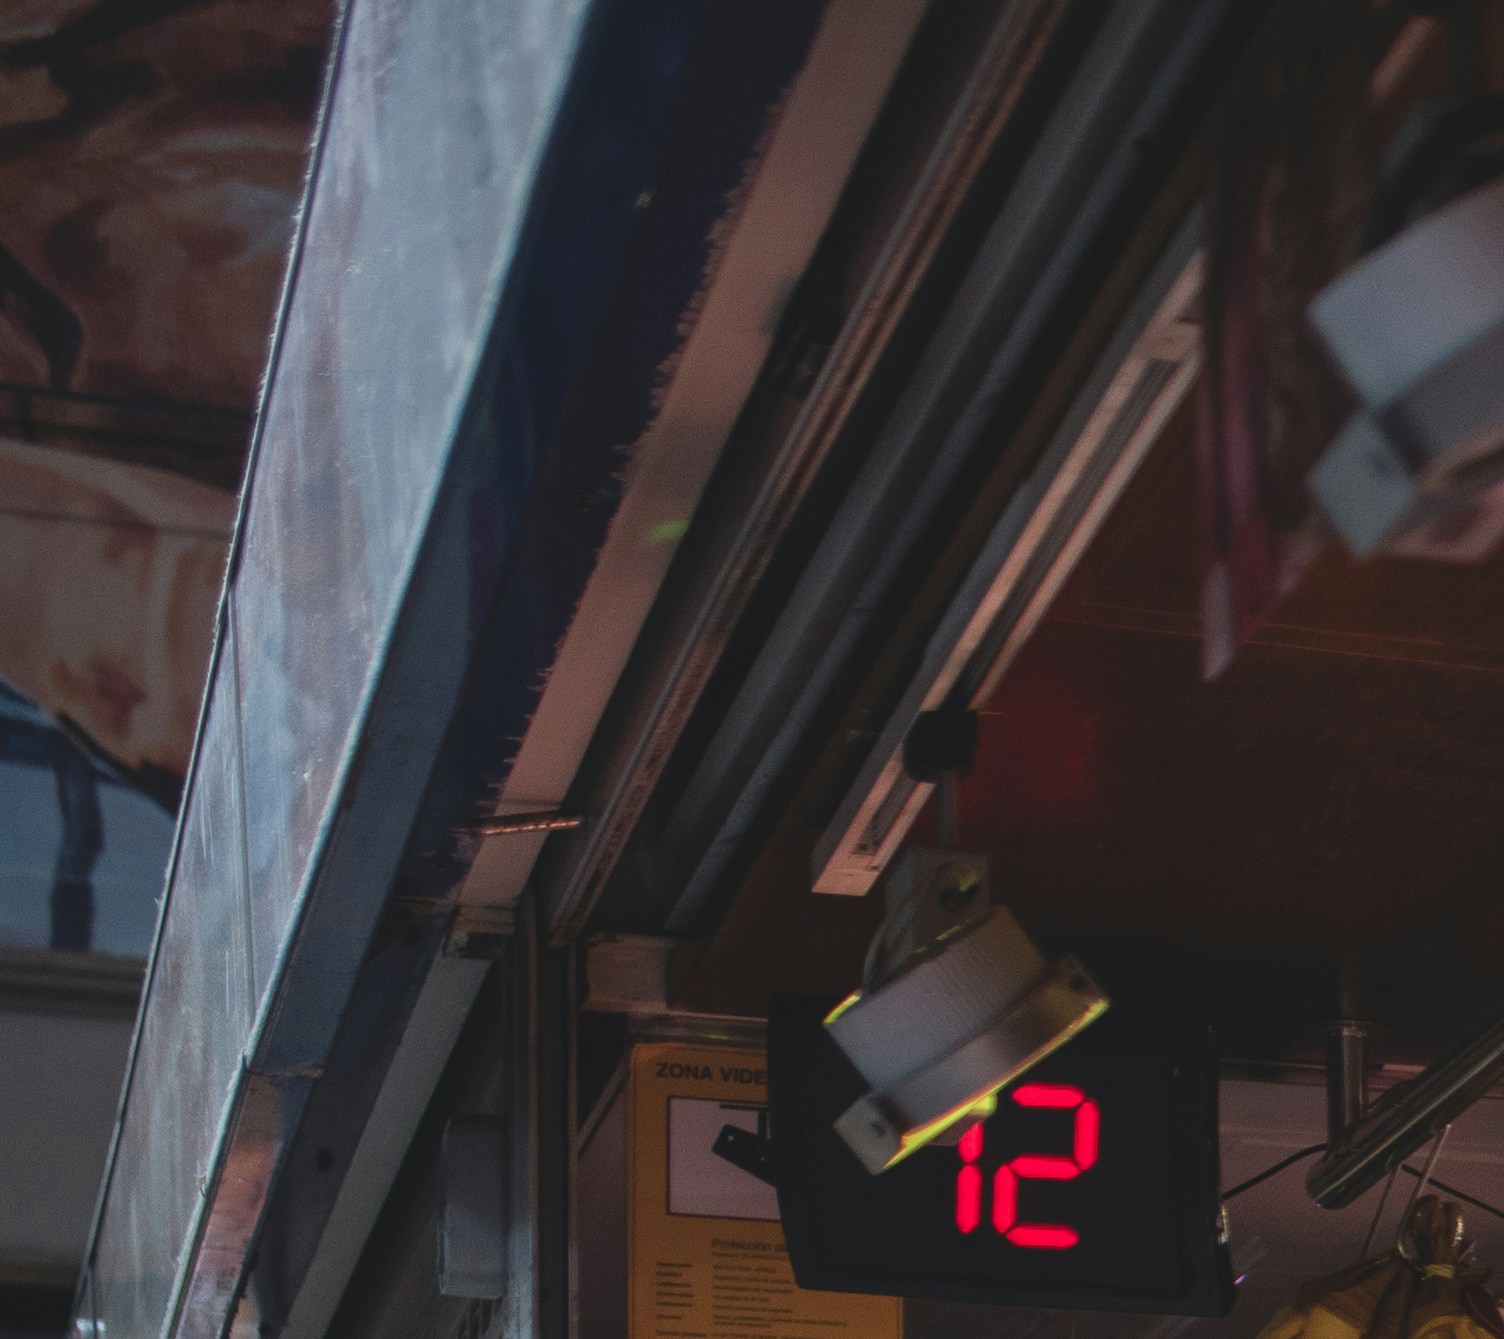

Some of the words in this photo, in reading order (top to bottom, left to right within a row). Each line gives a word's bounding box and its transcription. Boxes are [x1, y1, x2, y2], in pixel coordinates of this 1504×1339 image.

[656, 1062, 712, 1081] ZONA
[720, 1067, 767, 1085] VIDE
[955, 1084, 1100, 1249] 12
